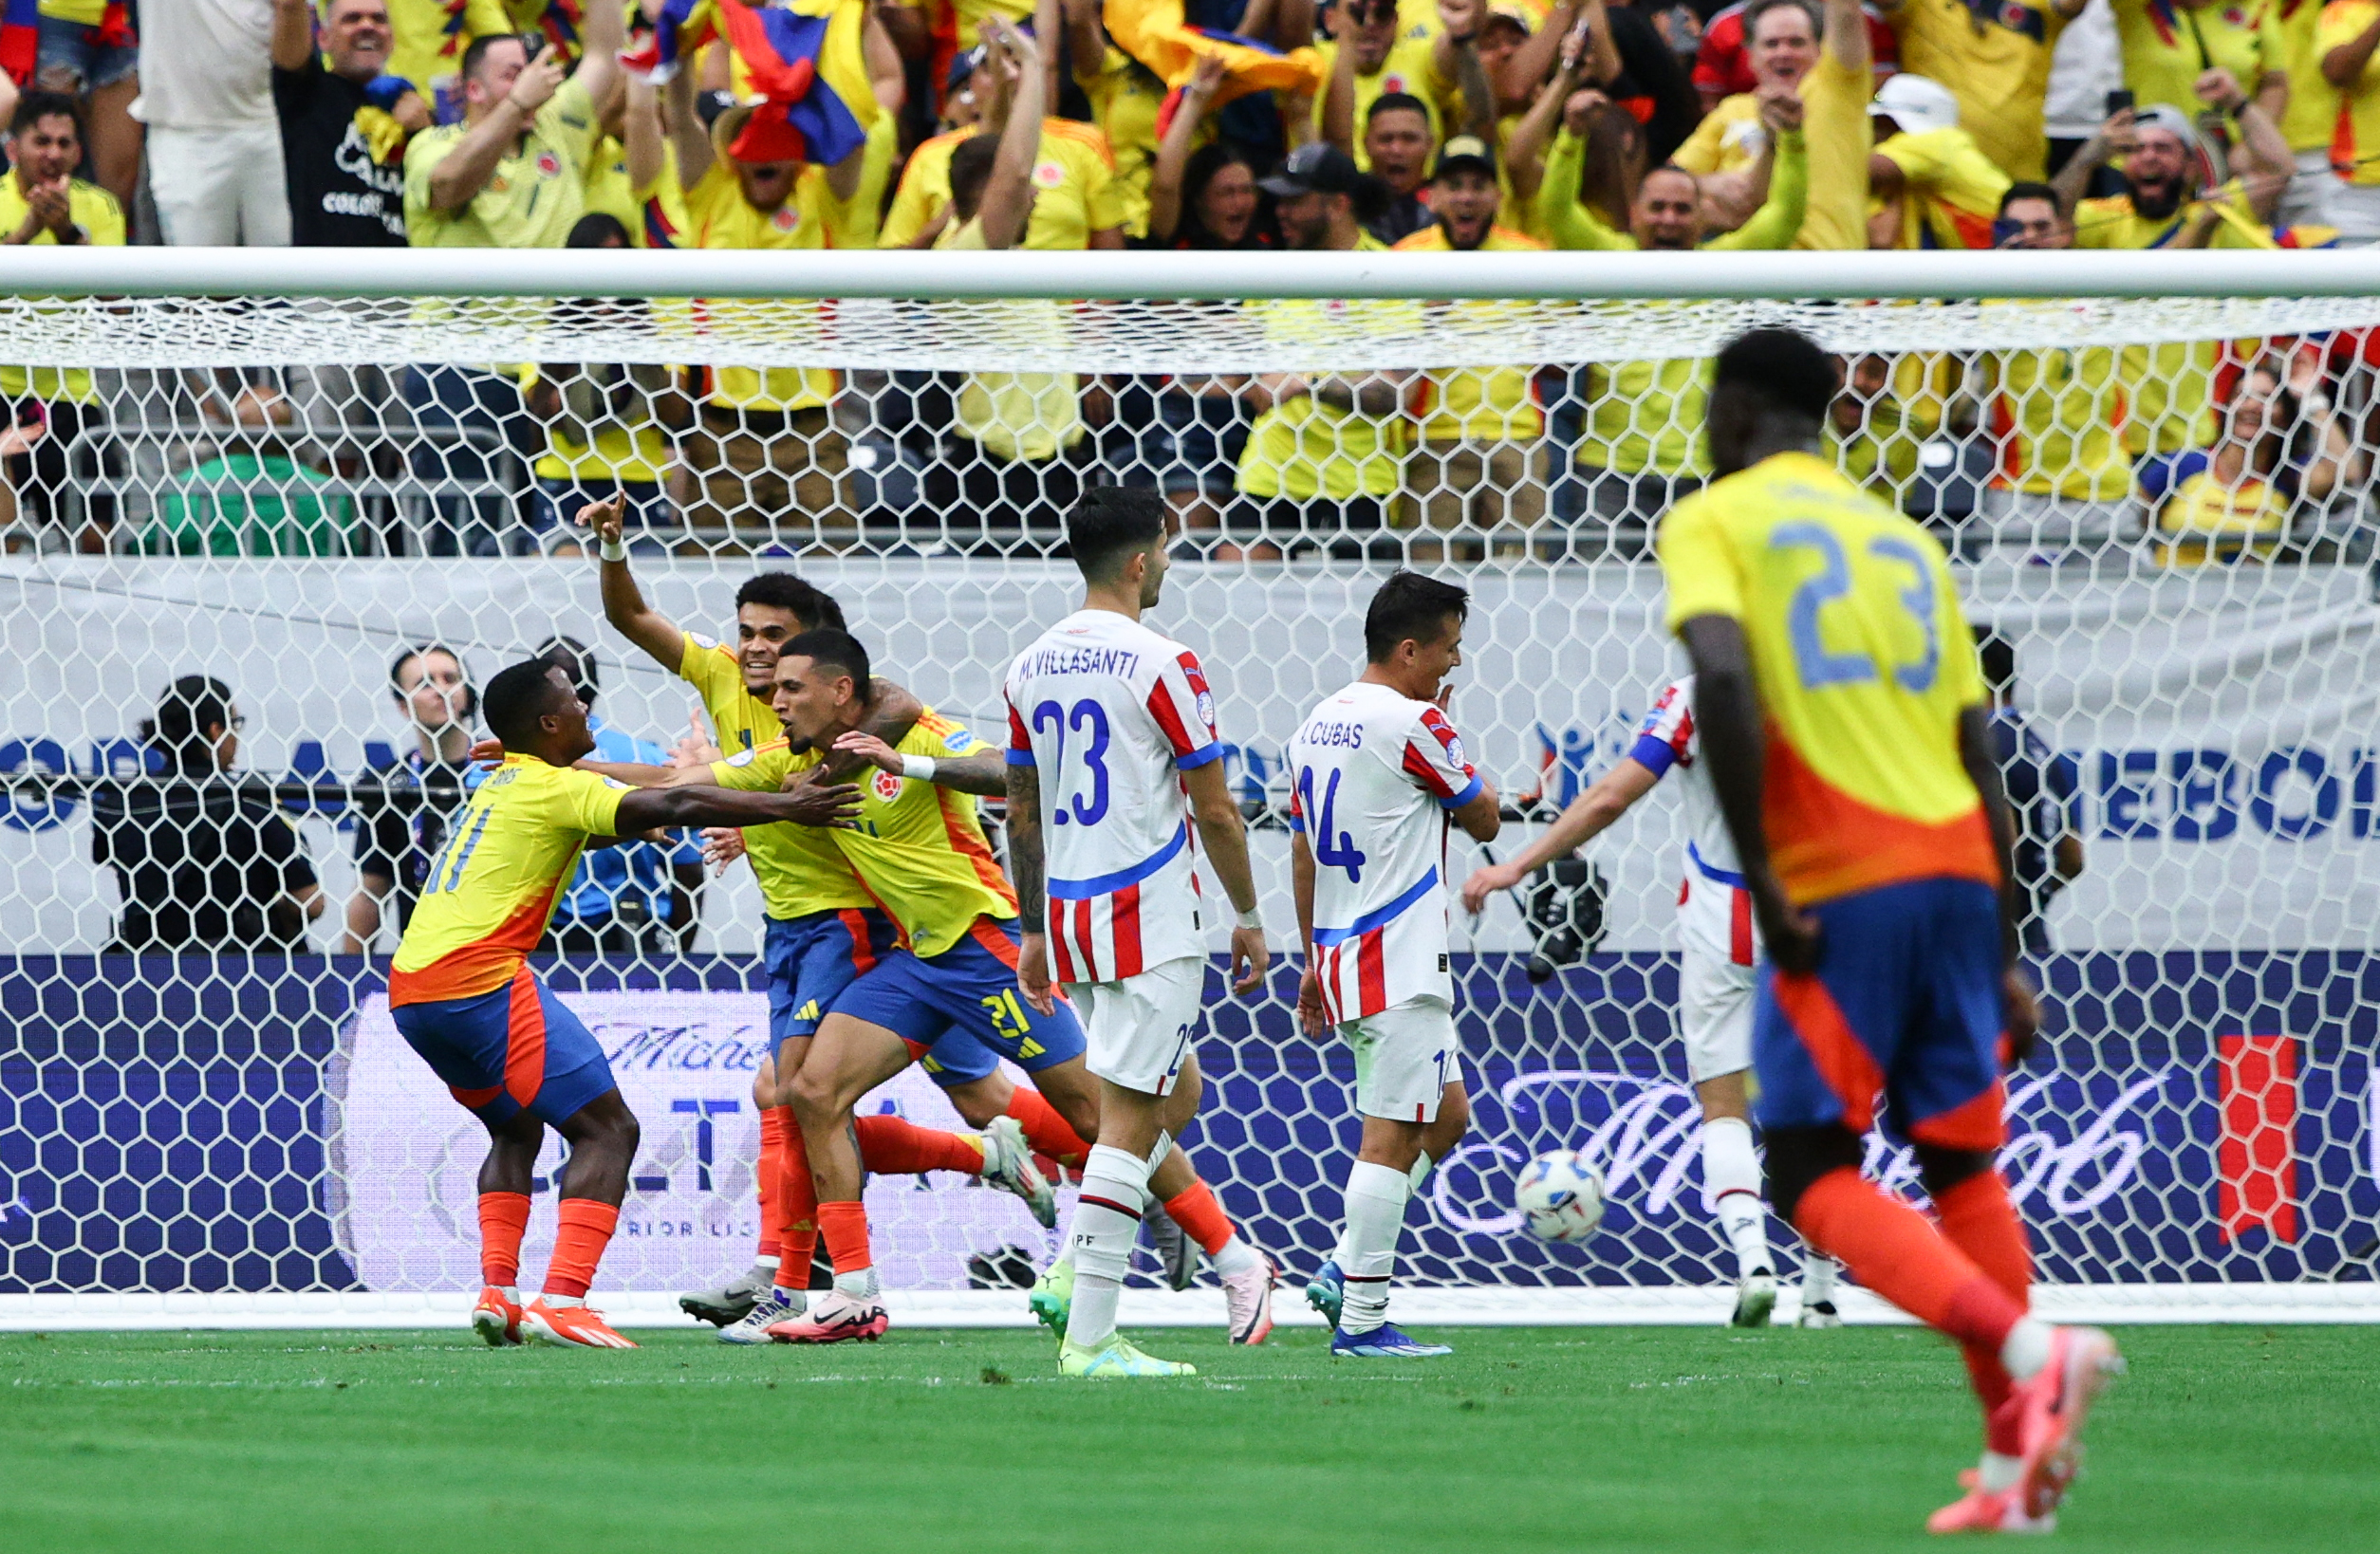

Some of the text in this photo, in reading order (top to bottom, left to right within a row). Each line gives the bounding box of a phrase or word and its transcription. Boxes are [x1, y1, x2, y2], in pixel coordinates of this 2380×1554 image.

[1767, 523, 1939, 694] 23
[1019, 648, 1139, 683] M.VILLASANTI
[1032, 698, 1110, 827] 23
[1298, 765, 1367, 883] 14
[980, 988, 1032, 1039] 21
[1166, 1023, 1194, 1077] 2
